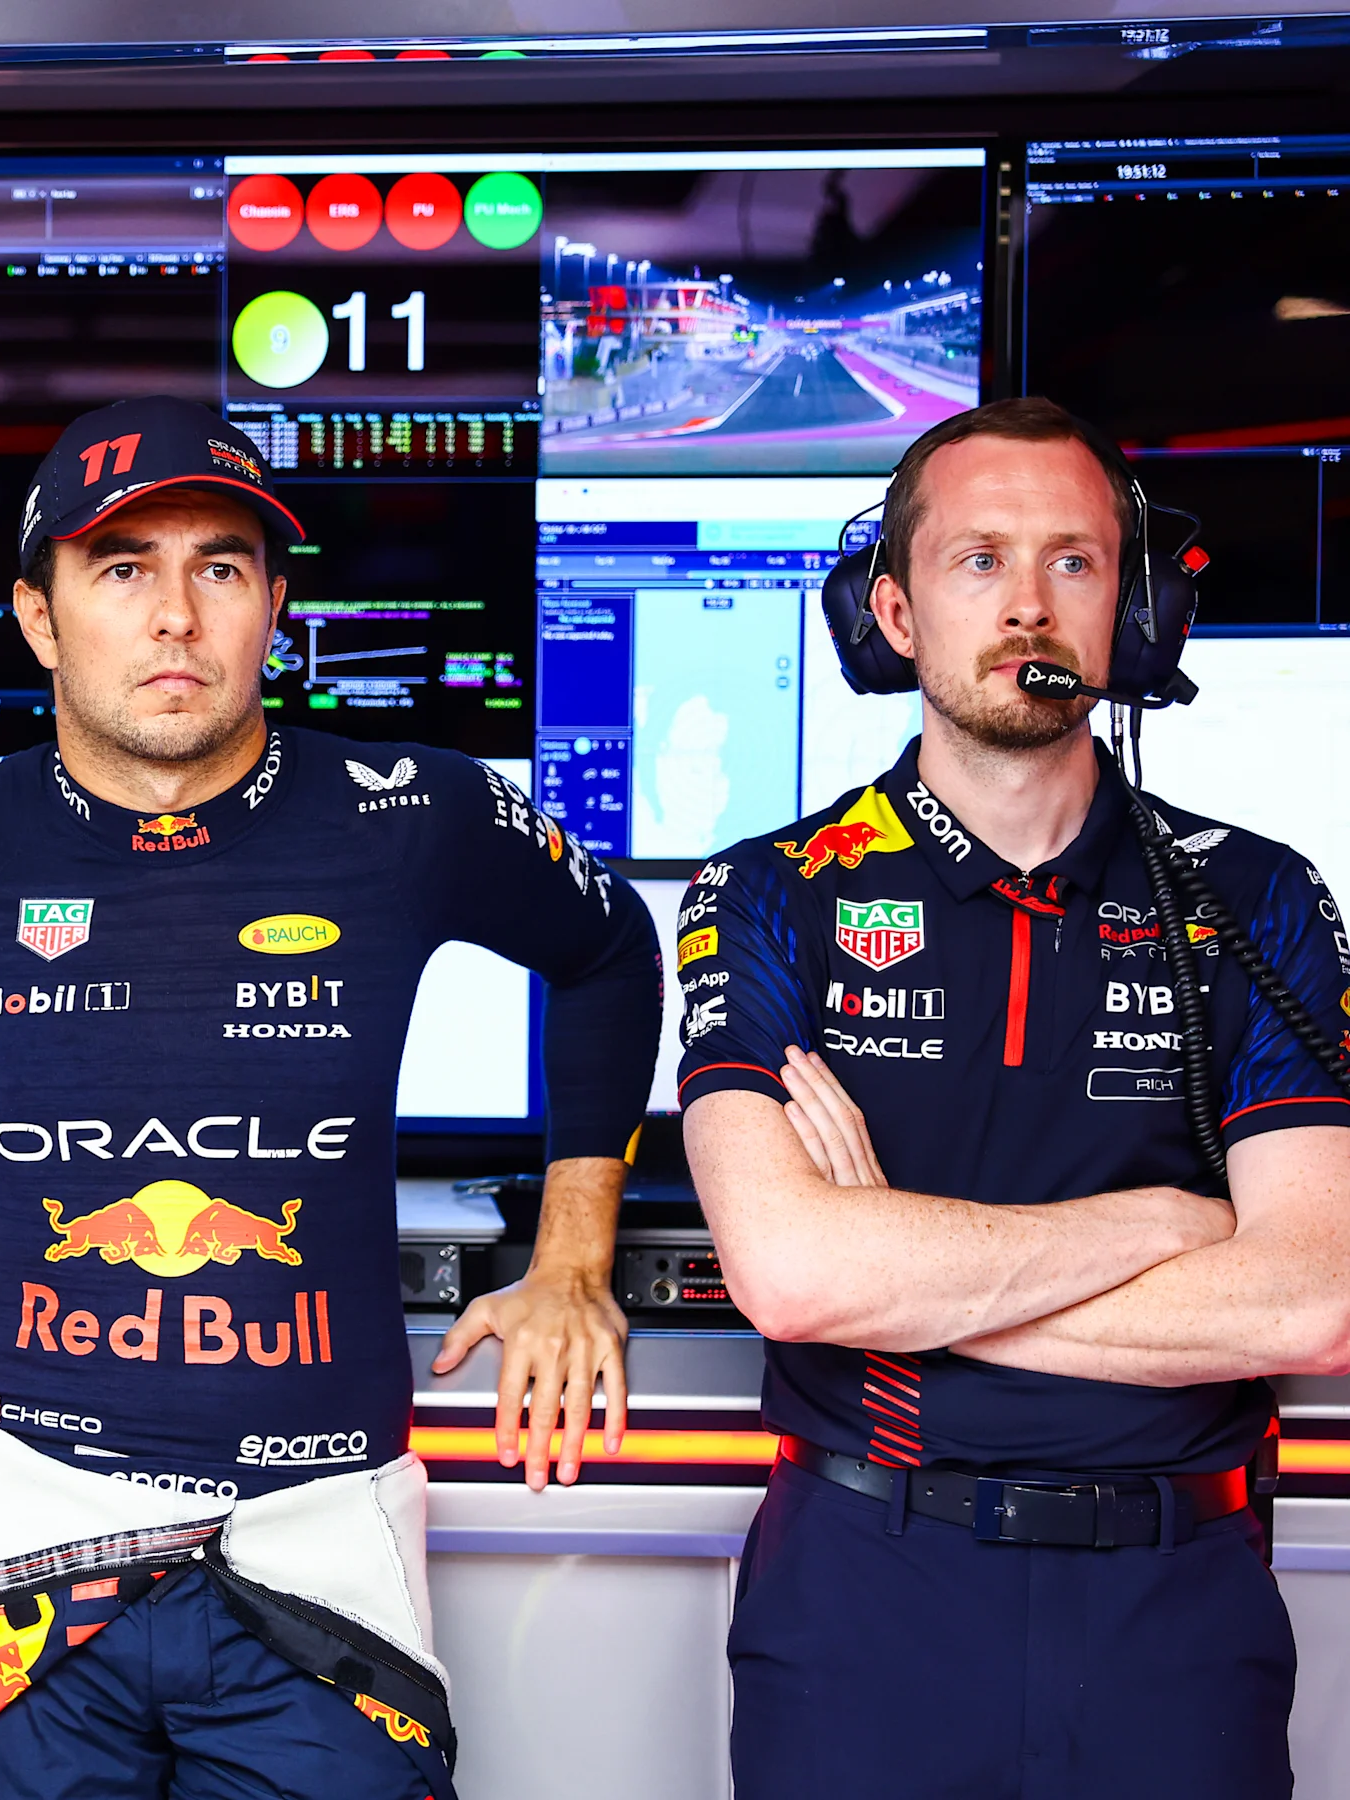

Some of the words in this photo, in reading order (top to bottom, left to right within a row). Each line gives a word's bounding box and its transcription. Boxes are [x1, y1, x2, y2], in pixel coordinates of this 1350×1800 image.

[332, 291, 426, 371] 11
[79, 433, 143, 487] 11
[1047, 673, 1077, 690] poly
[358, 793, 431, 813] CASTORE
[906, 781, 972, 862] zoom
[131, 834, 170, 852] Red
[172, 826, 211, 851] Bull
[27, 903, 86, 923] TAG
[843, 904, 916, 928] TAG
[23, 926, 85, 957] HEUER
[266, 925, 328, 944] RAUCH
[1099, 923, 1130, 944] Red
[840, 931, 919, 969] HEUER
[1101, 944, 1220, 962] RACIG
[236, 975, 345, 1008] BYBIT
[698, 970, 730, 989] App
[826, 979, 906, 1019] Mobil
[222, 1022, 352, 1039] HONDA
[824, 1028, 944, 1060] ORACLE
[1136, 1078, 1174, 1091] RICH
[15, 1281, 163, 1363] Red
[183, 1290, 332, 1367] Bull
[0, 1403, 102, 1435] CHECO
[237, 1428, 368, 1467] sparco
